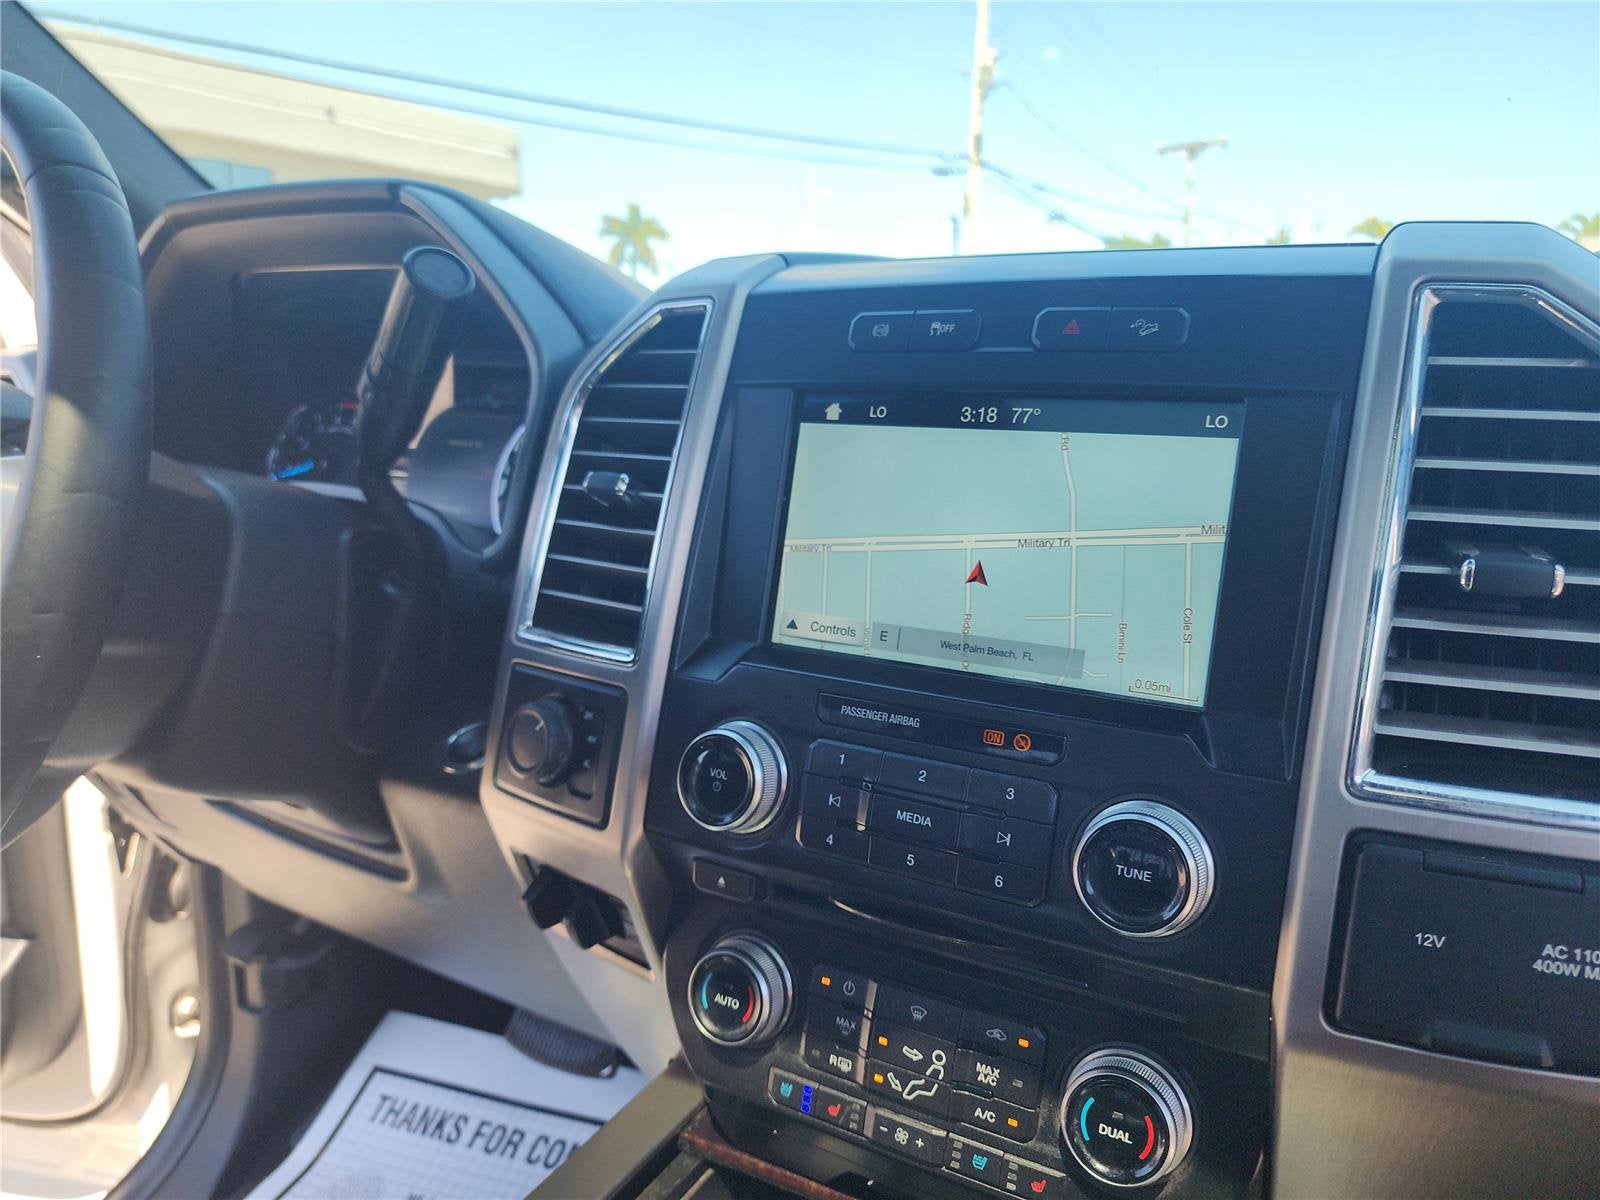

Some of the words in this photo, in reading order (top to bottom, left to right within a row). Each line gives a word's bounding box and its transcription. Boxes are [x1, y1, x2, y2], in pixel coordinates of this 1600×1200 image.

[940, 324, 956, 333] OFF
[869, 406, 887, 418] LO
[960, 406, 998, 423] 3:18
[1011, 407, 1041, 424] 77°
[1205, 414, 1229, 429] LO
[1017, 538, 1054, 550] Military
[1183, 607, 1193, 631] Cole
[810, 620, 857, 638] Controls
[879, 630, 888, 642] E
[1182, 633, 1193, 644] St
[940, 640, 961, 651] West
[962, 643, 985, 655] Palm
[986, 647, 1018, 660] Beach,
[1022, 651, 1034, 662] FL
[1134, 678, 1172, 693] 0.05mi
[840, 704, 888, 722] PASSENGER
[888, 714, 921, 728] AIRBAG
[986, 731, 1001, 744] ON
[838, 753, 846, 766] 1
[709, 766, 728, 781] VOL
[917, 769, 927, 783] 2
[1005, 787, 1015, 800] 3
[895, 809, 932, 828] MEDIA
[825, 833, 834, 846] 4
[906, 853, 915, 867] 5
[994, 874, 1004, 888] 6
[1115, 864, 1152, 883] TUNE
[1415, 932, 1446, 948] 12V
[1541, 944, 1569, 959] AC
[1573, 948, 1600, 964] 110
[1532, 959, 1581, 978] 400W
[1584, 965, 1600, 980] M
[714, 992, 740, 1010] AUTO
[835, 1015, 857, 1031] MAX
[975, 1061, 1000, 1078] MAX
[977, 1072, 998, 1087] A/C
[974, 1106, 996, 1123] A/C
[368, 1093, 469, 1144] THANKS
[467, 1119, 525, 1159] FOR
[526, 1133, 580, 1169] CO
[1098, 1122, 1134, 1145] DUAL
